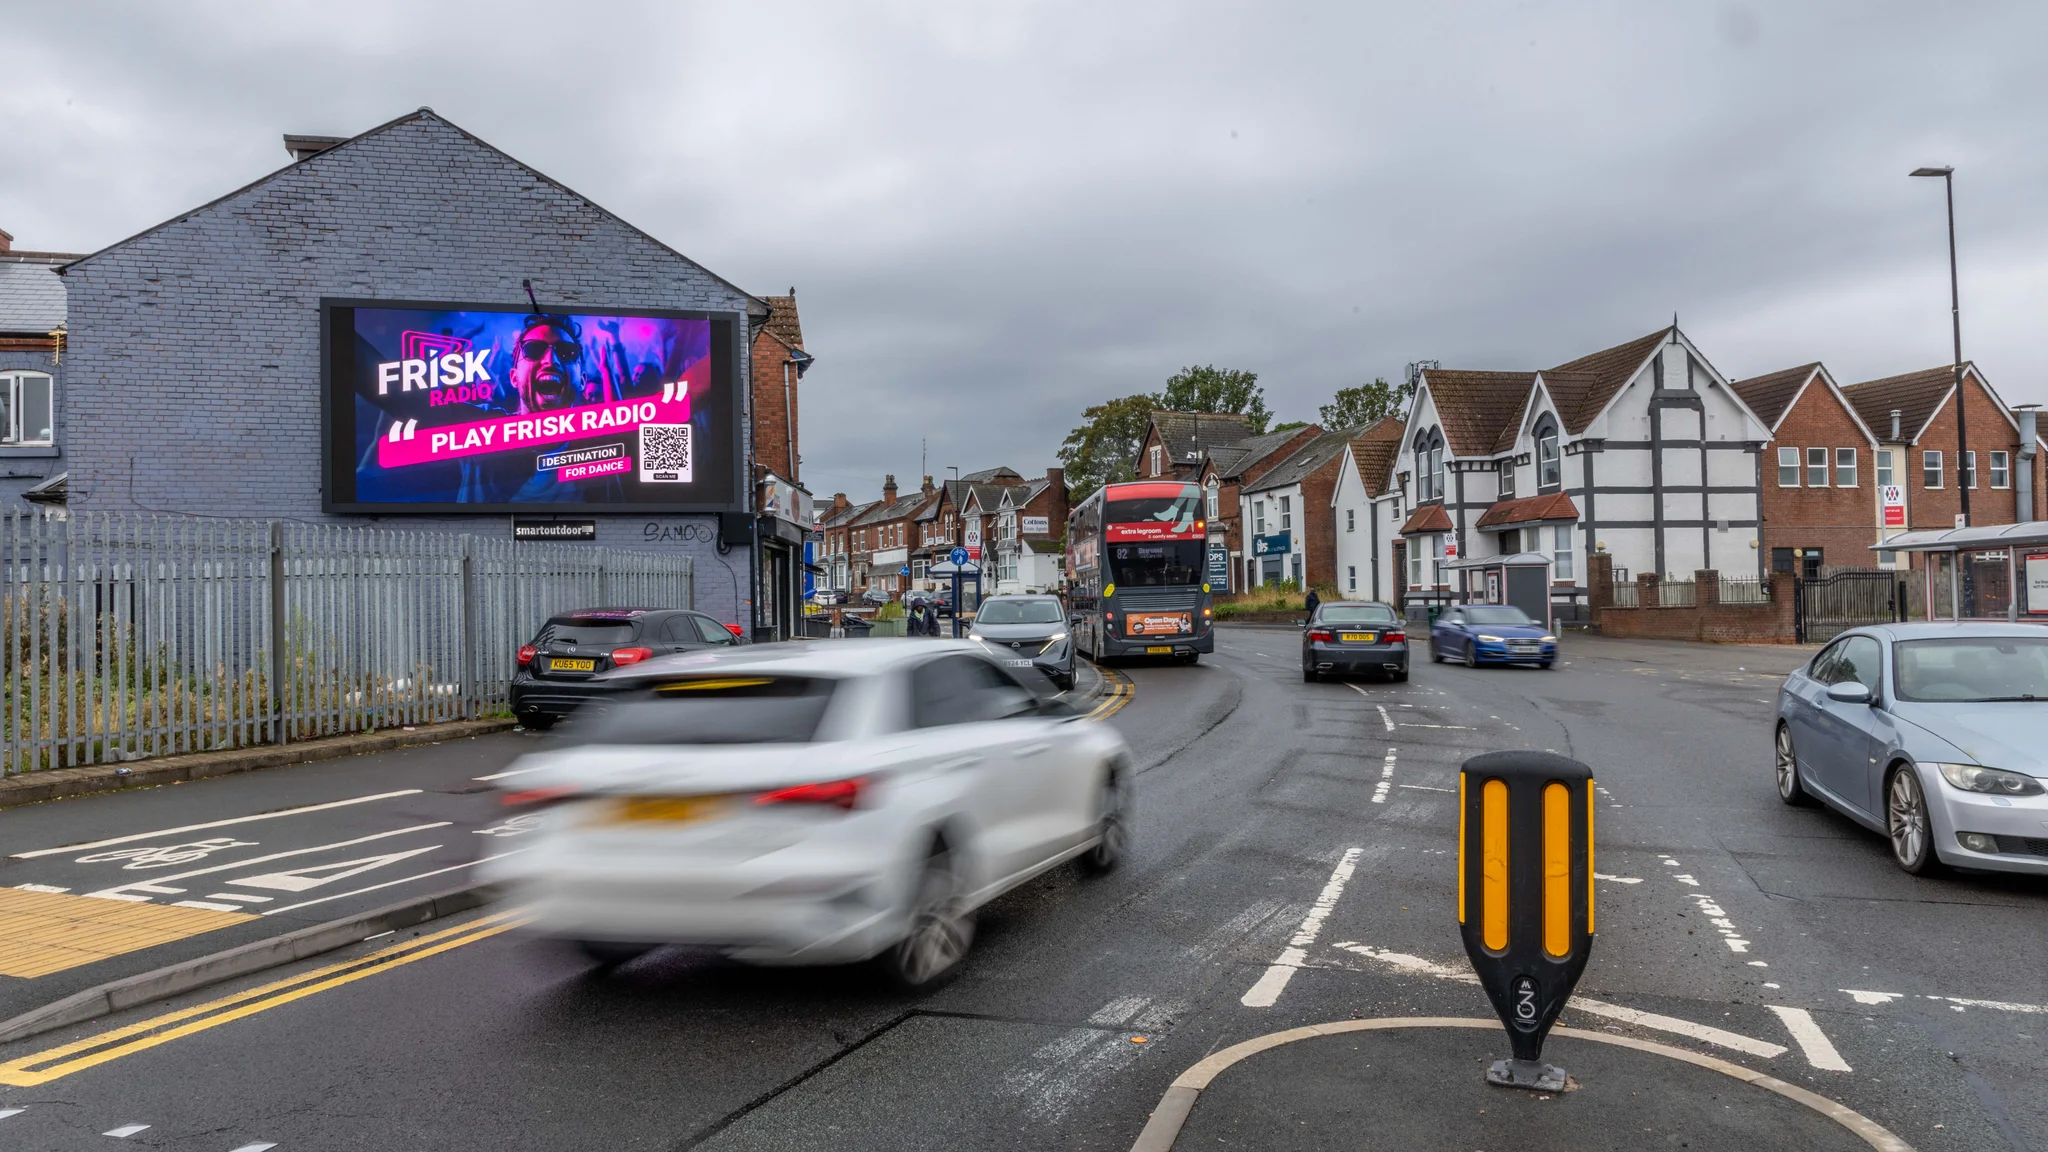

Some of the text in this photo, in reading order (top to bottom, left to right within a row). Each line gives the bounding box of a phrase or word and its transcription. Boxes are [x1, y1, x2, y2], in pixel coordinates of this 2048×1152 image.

[432, 425, 497, 453] PLAY
[502, 413, 576, 443] FRISK
[582, 402, 657, 430] RADIO
[546, 448, 617, 467] DESTINATION
[565, 461, 624, 478] FOR DANCE
[516, 524, 582, 536] smartoutdoor
[1137, 528, 1162, 536] legroom
[1144, 617, 1163, 625] Open
[1163, 616, 1180, 626] Days
[553, 658, 574, 669] KU65
